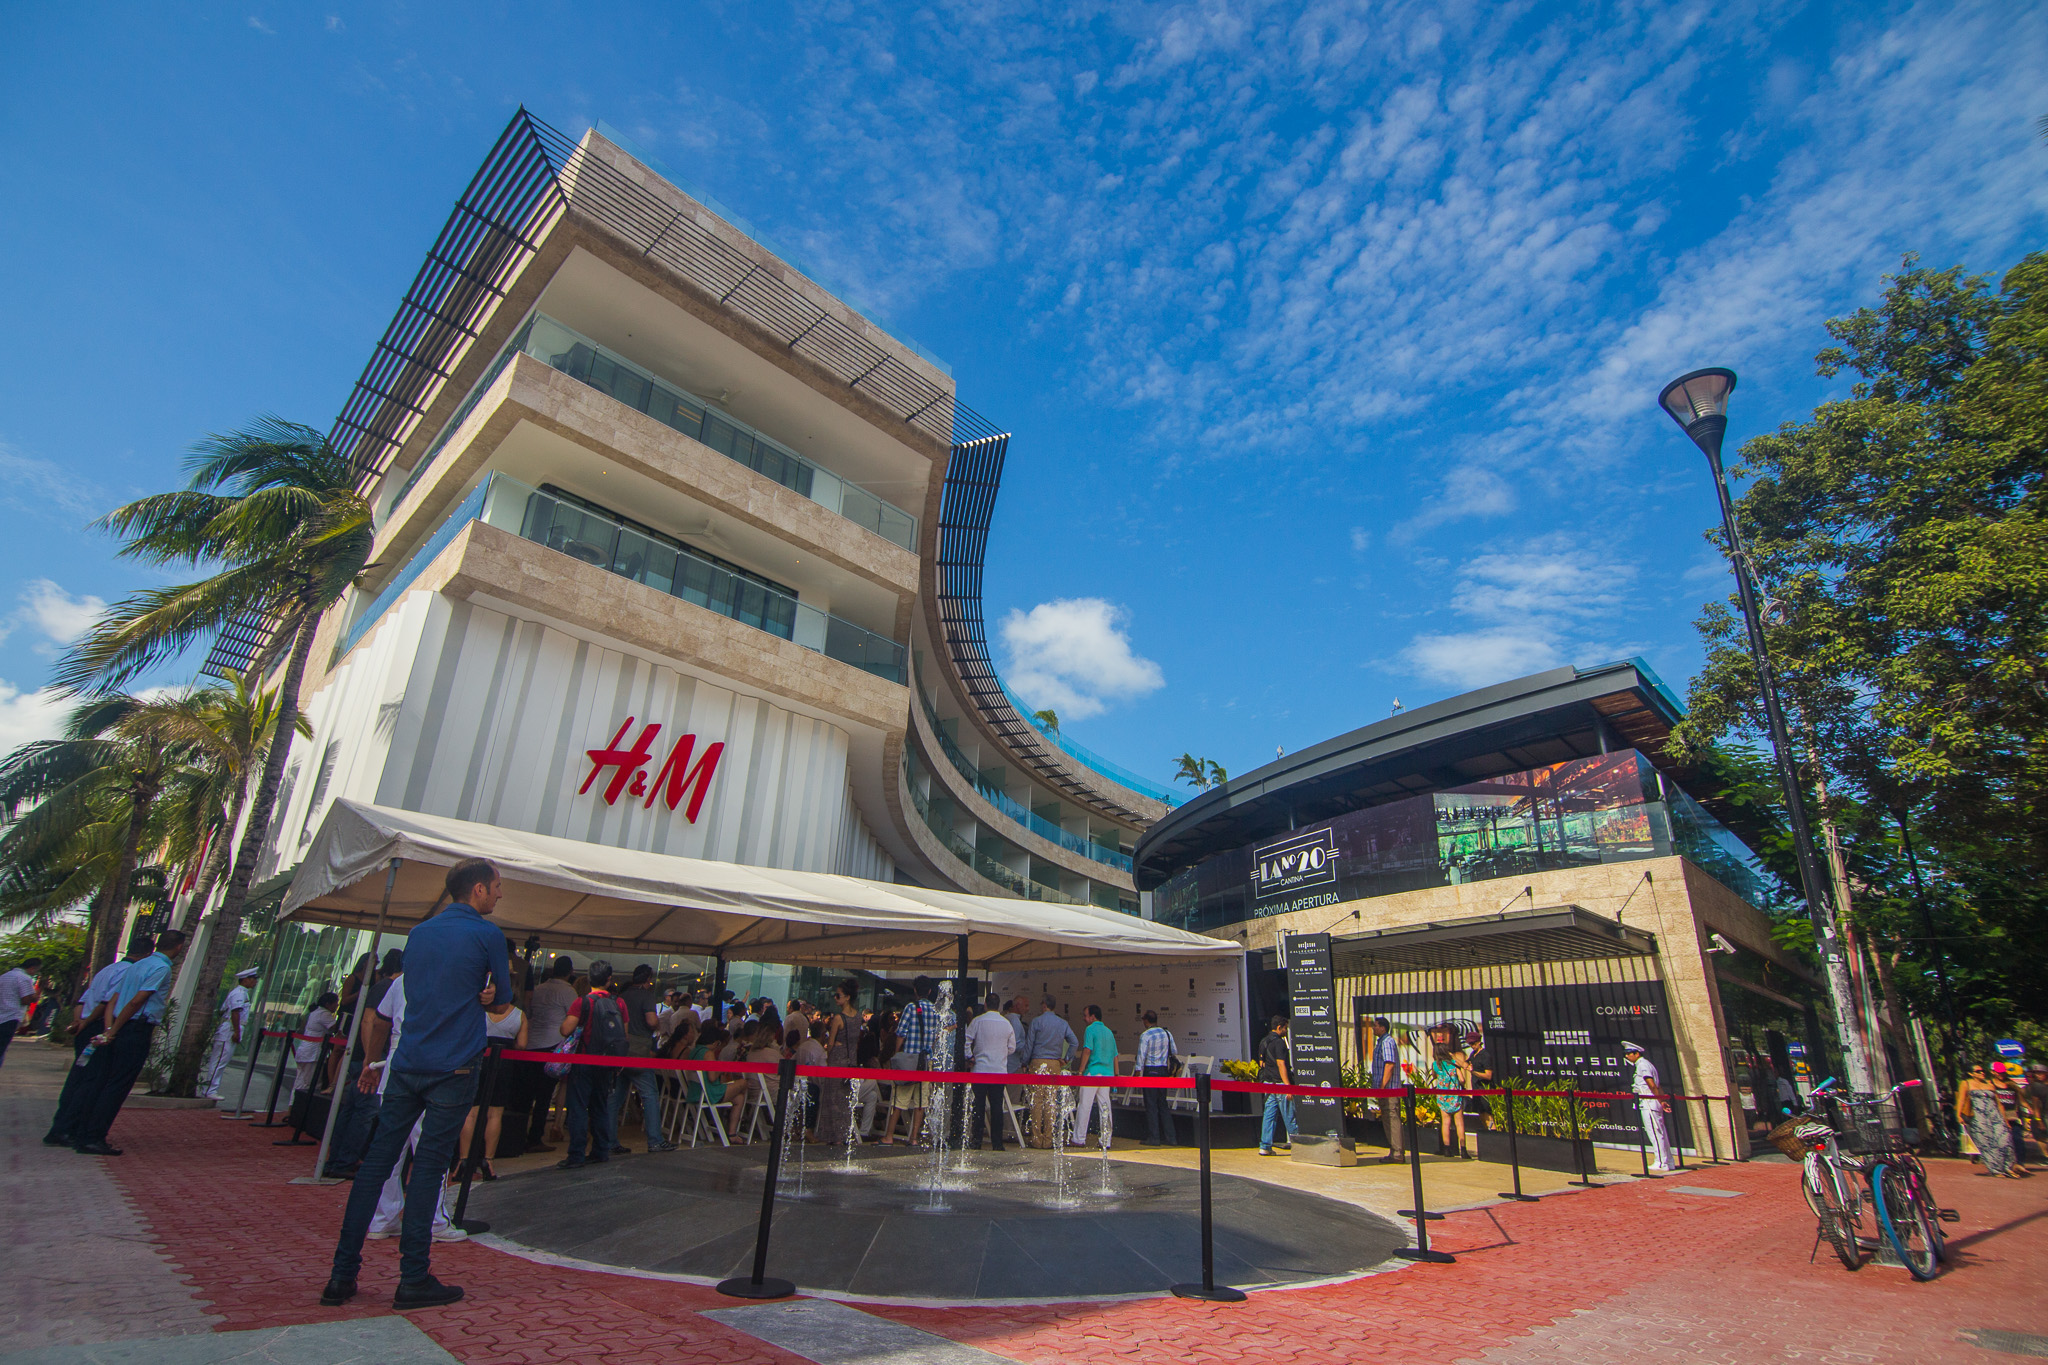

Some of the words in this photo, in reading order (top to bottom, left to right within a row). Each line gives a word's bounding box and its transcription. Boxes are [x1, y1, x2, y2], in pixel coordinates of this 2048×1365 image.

[579, 716, 725, 824] H&M
[1260, 860, 1282, 882] LA
[1297, 846, 1326, 873] 20
[1280, 875, 1304, 886] CANTINA
[1254, 902, 1290, 918] PRÓXIMA
[1291, 892, 1340, 910] APERTURA
[1596, 1004, 1658, 1015] COMMUNE
[1512, 1056, 1635, 1066] THOMPSON
